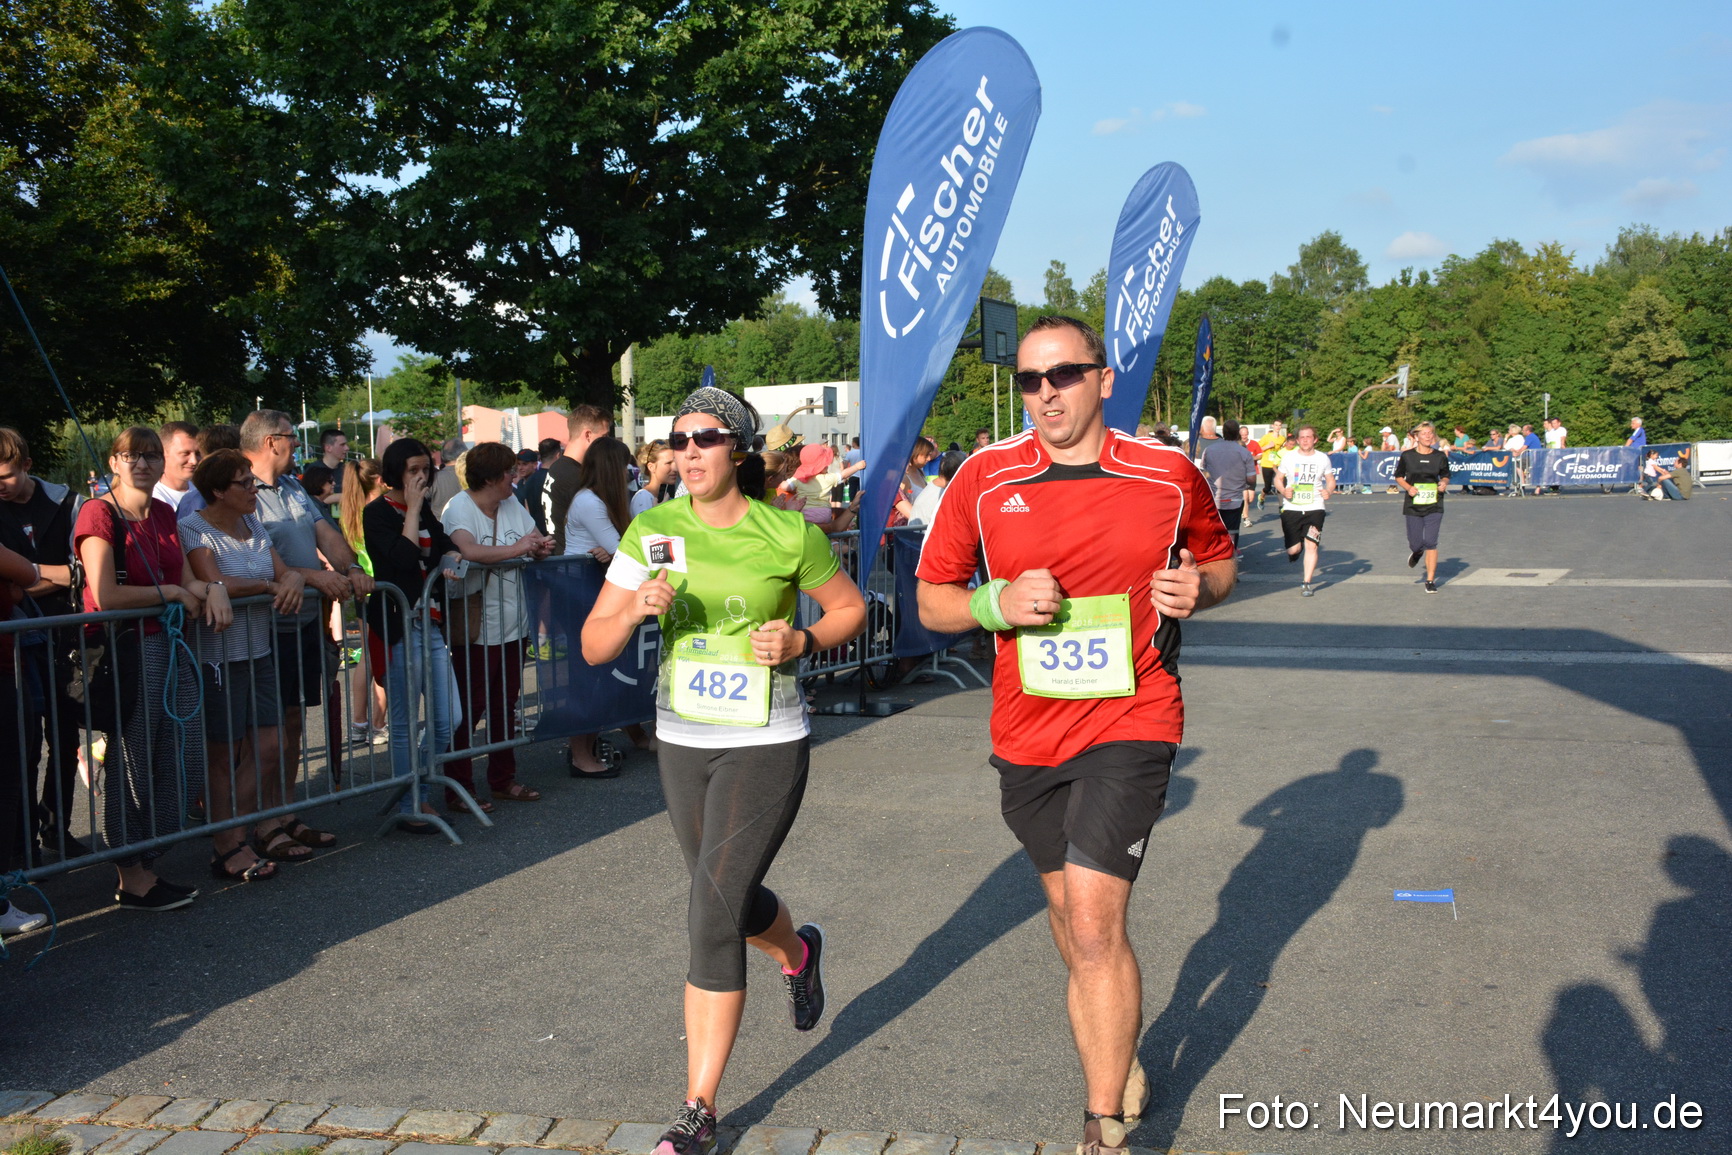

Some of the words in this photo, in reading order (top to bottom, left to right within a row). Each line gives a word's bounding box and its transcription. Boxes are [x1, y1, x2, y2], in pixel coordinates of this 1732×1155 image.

[898, 75, 993, 301] Fischer
[936, 112, 1008, 294] AUTOMOBILE
[1125, 194, 1177, 348] Fischer
[1565, 462, 1622, 474] Fischer
[1000, 505, 1030, 513] adidas
[651, 544, 664, 552] my
[652, 551, 665, 561] life
[1039, 638, 1109, 671] 335
[688, 669, 748, 701] 482
[696, 703, 718, 713] Simone
[718, 705, 739, 713] Eibner
